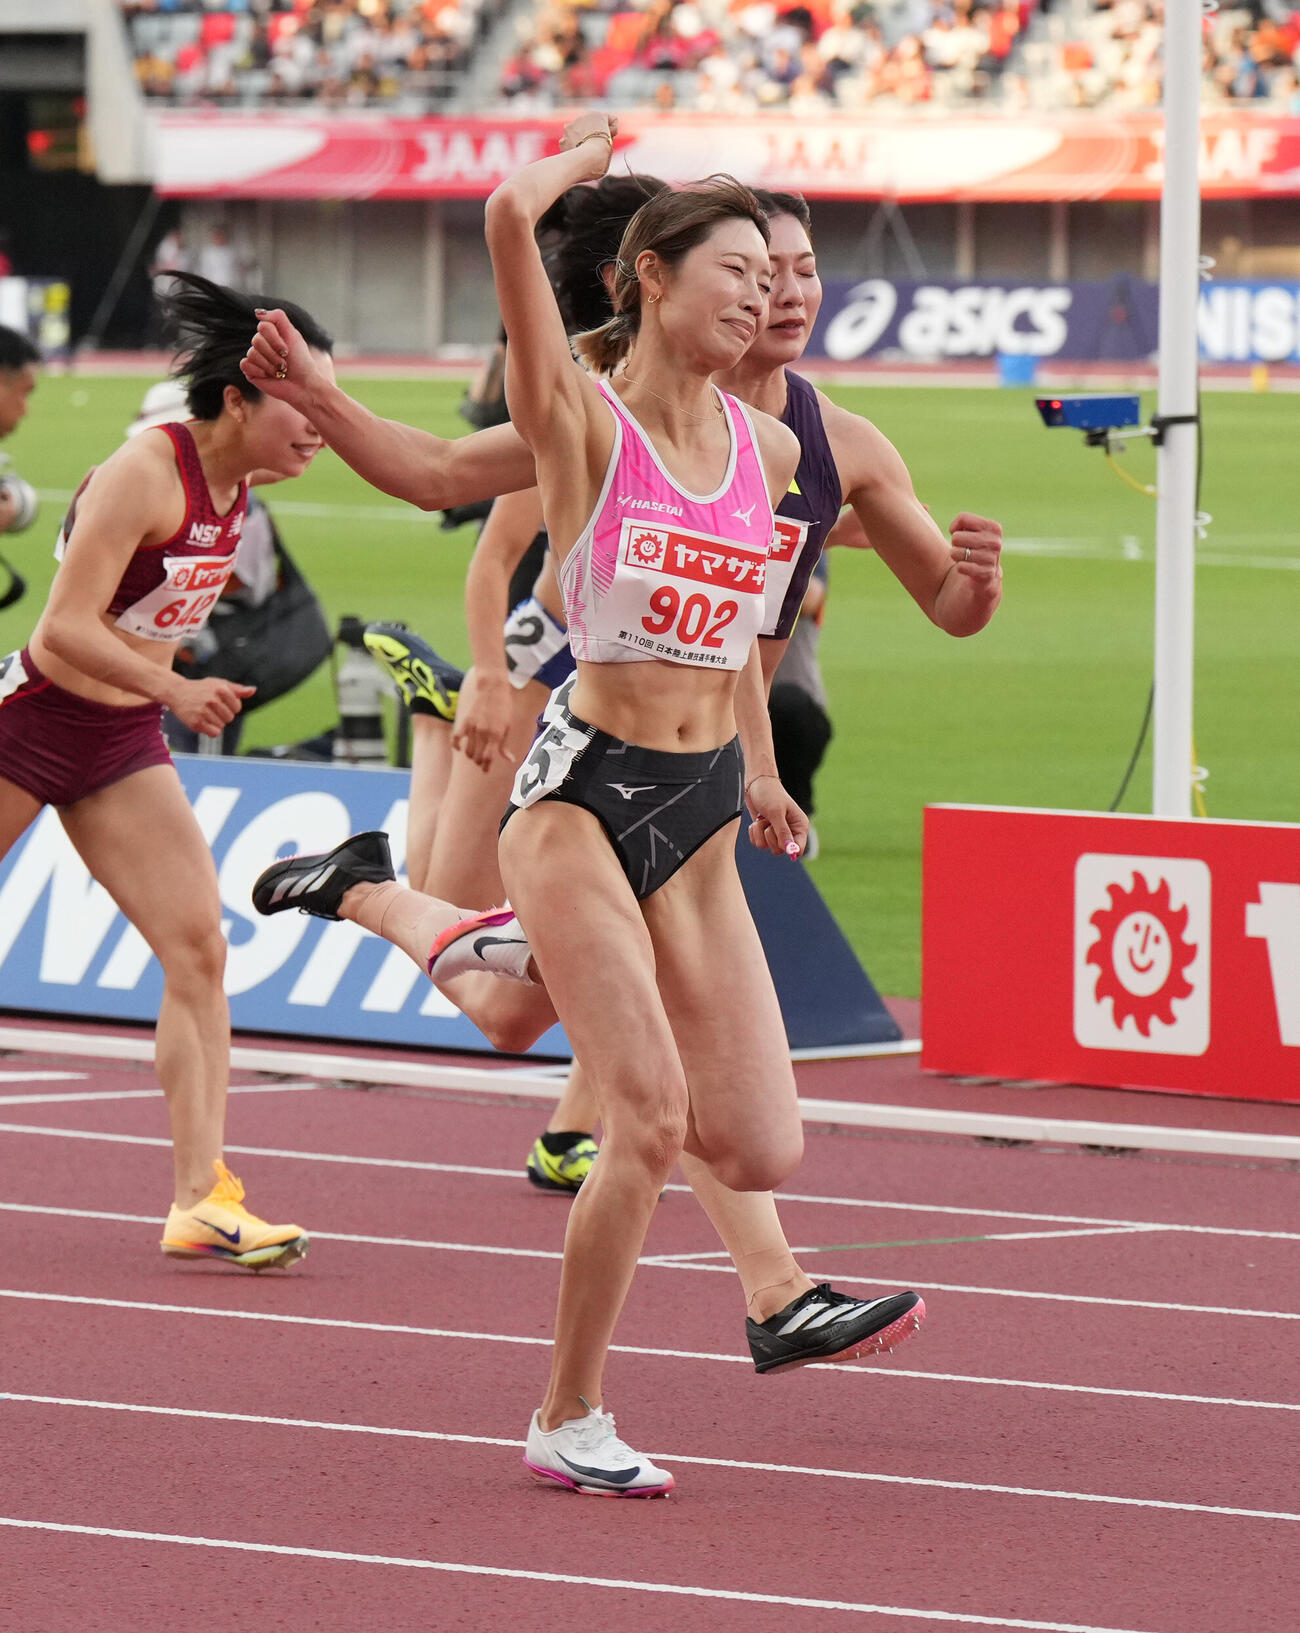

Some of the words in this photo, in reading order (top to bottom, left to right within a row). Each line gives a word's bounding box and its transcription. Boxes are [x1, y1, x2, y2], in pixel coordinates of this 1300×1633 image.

[414, 129, 549, 182] JAAF
[898, 286, 1073, 357] asics
[1198, 285, 1300, 360] NIS
[631, 499, 683, 517] HASETAI
[618, 630, 655, 649] 第110回
[641, 585, 739, 649] 902
